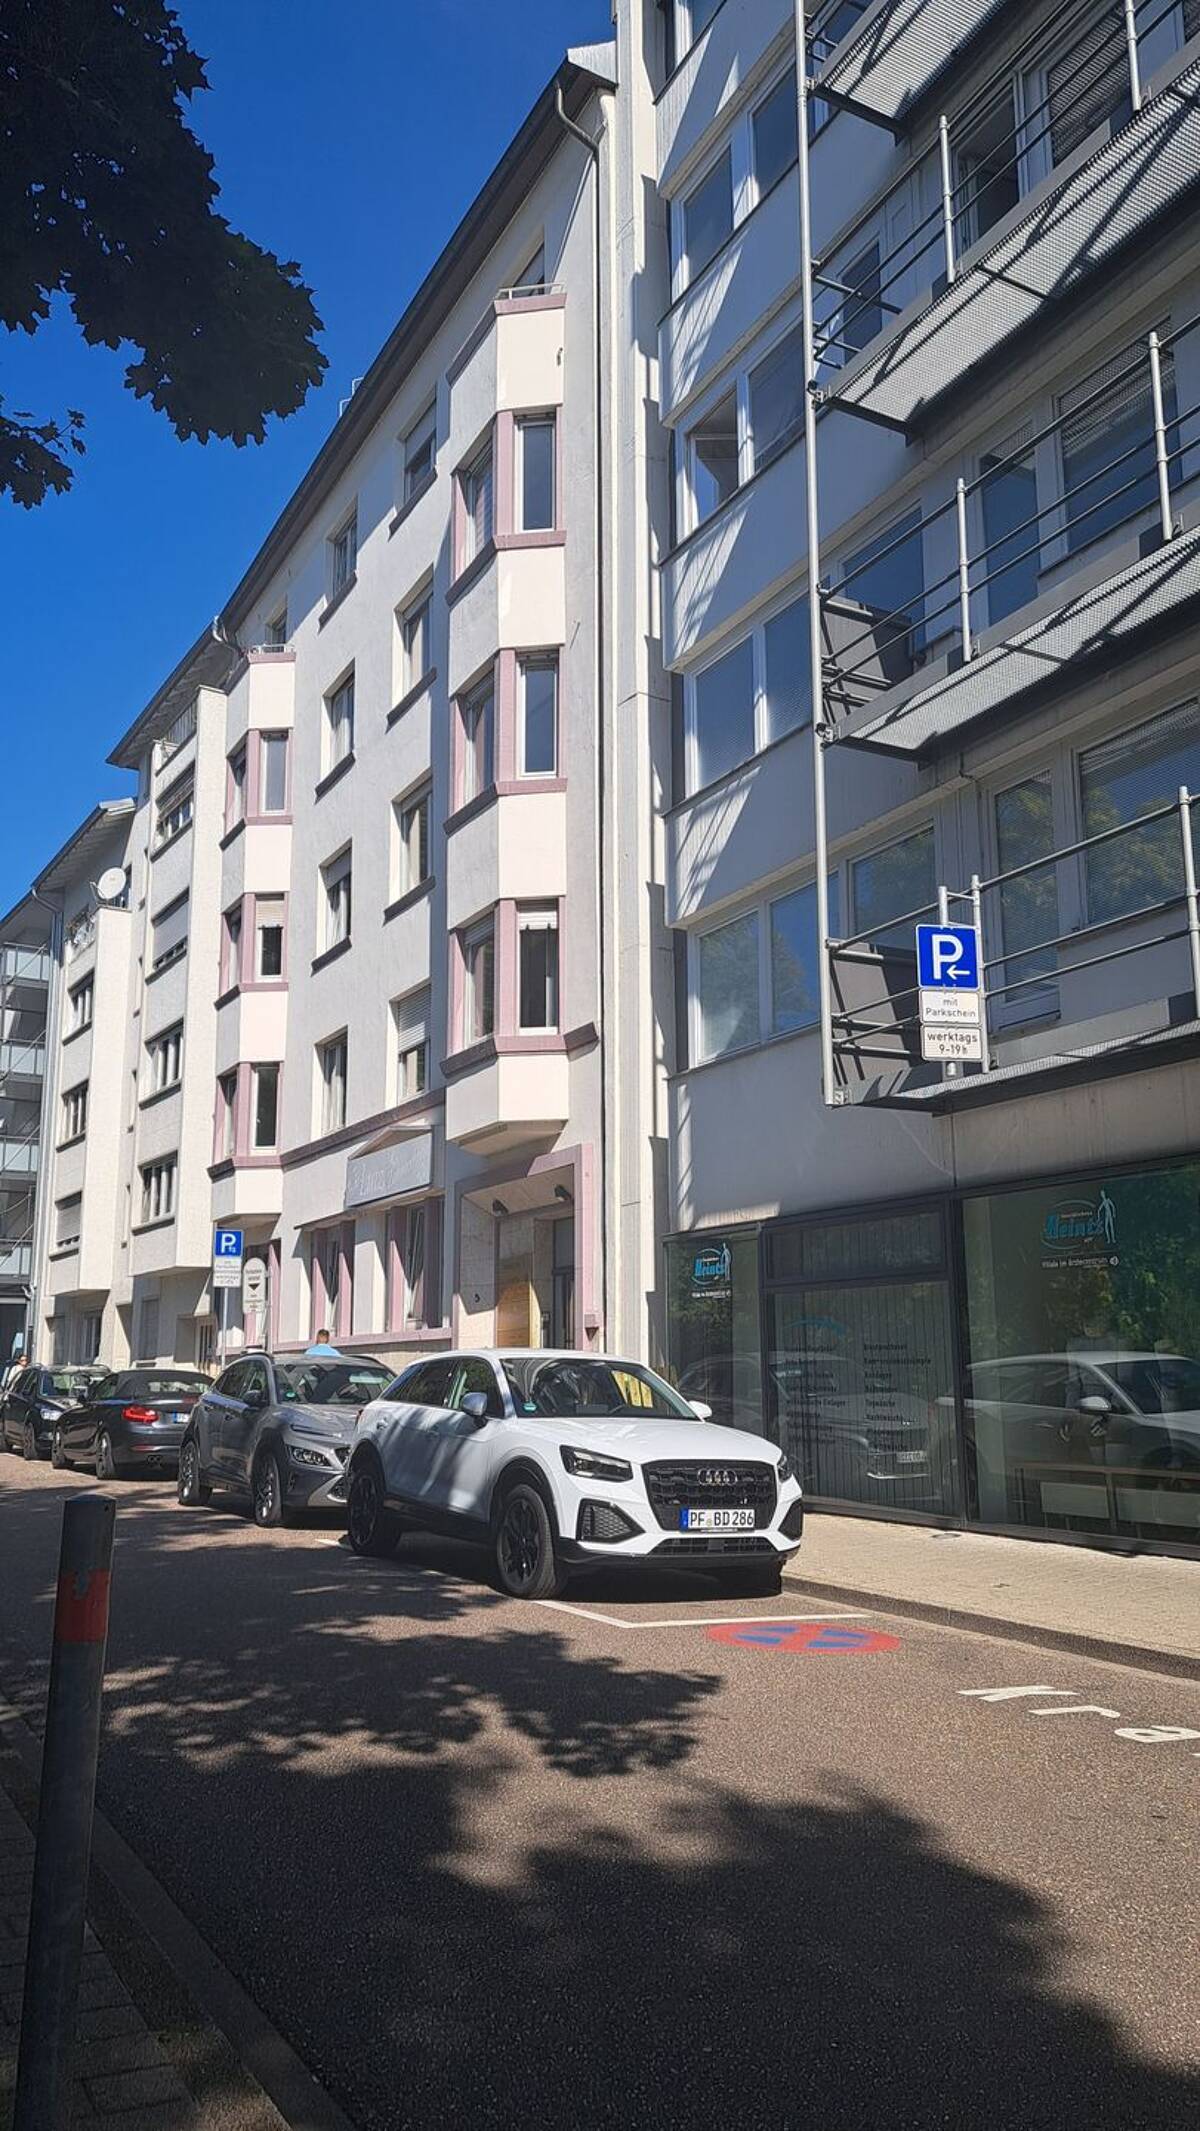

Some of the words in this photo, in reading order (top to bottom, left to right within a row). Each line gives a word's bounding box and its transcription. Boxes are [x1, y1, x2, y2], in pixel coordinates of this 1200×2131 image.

[931, 934, 963, 980] P
[943, 998, 958, 1007] mit
[926, 1007, 976, 1018] Parkschein
[927, 1033, 978, 1045] werktags
[221, 1233, 237, 1254] P
[690, 1511, 706, 1526] PF
[714, 1511, 731, 1526] BD
[732, 1511, 754, 1526] 286
[957, 1684, 1200, 1757] Kra
